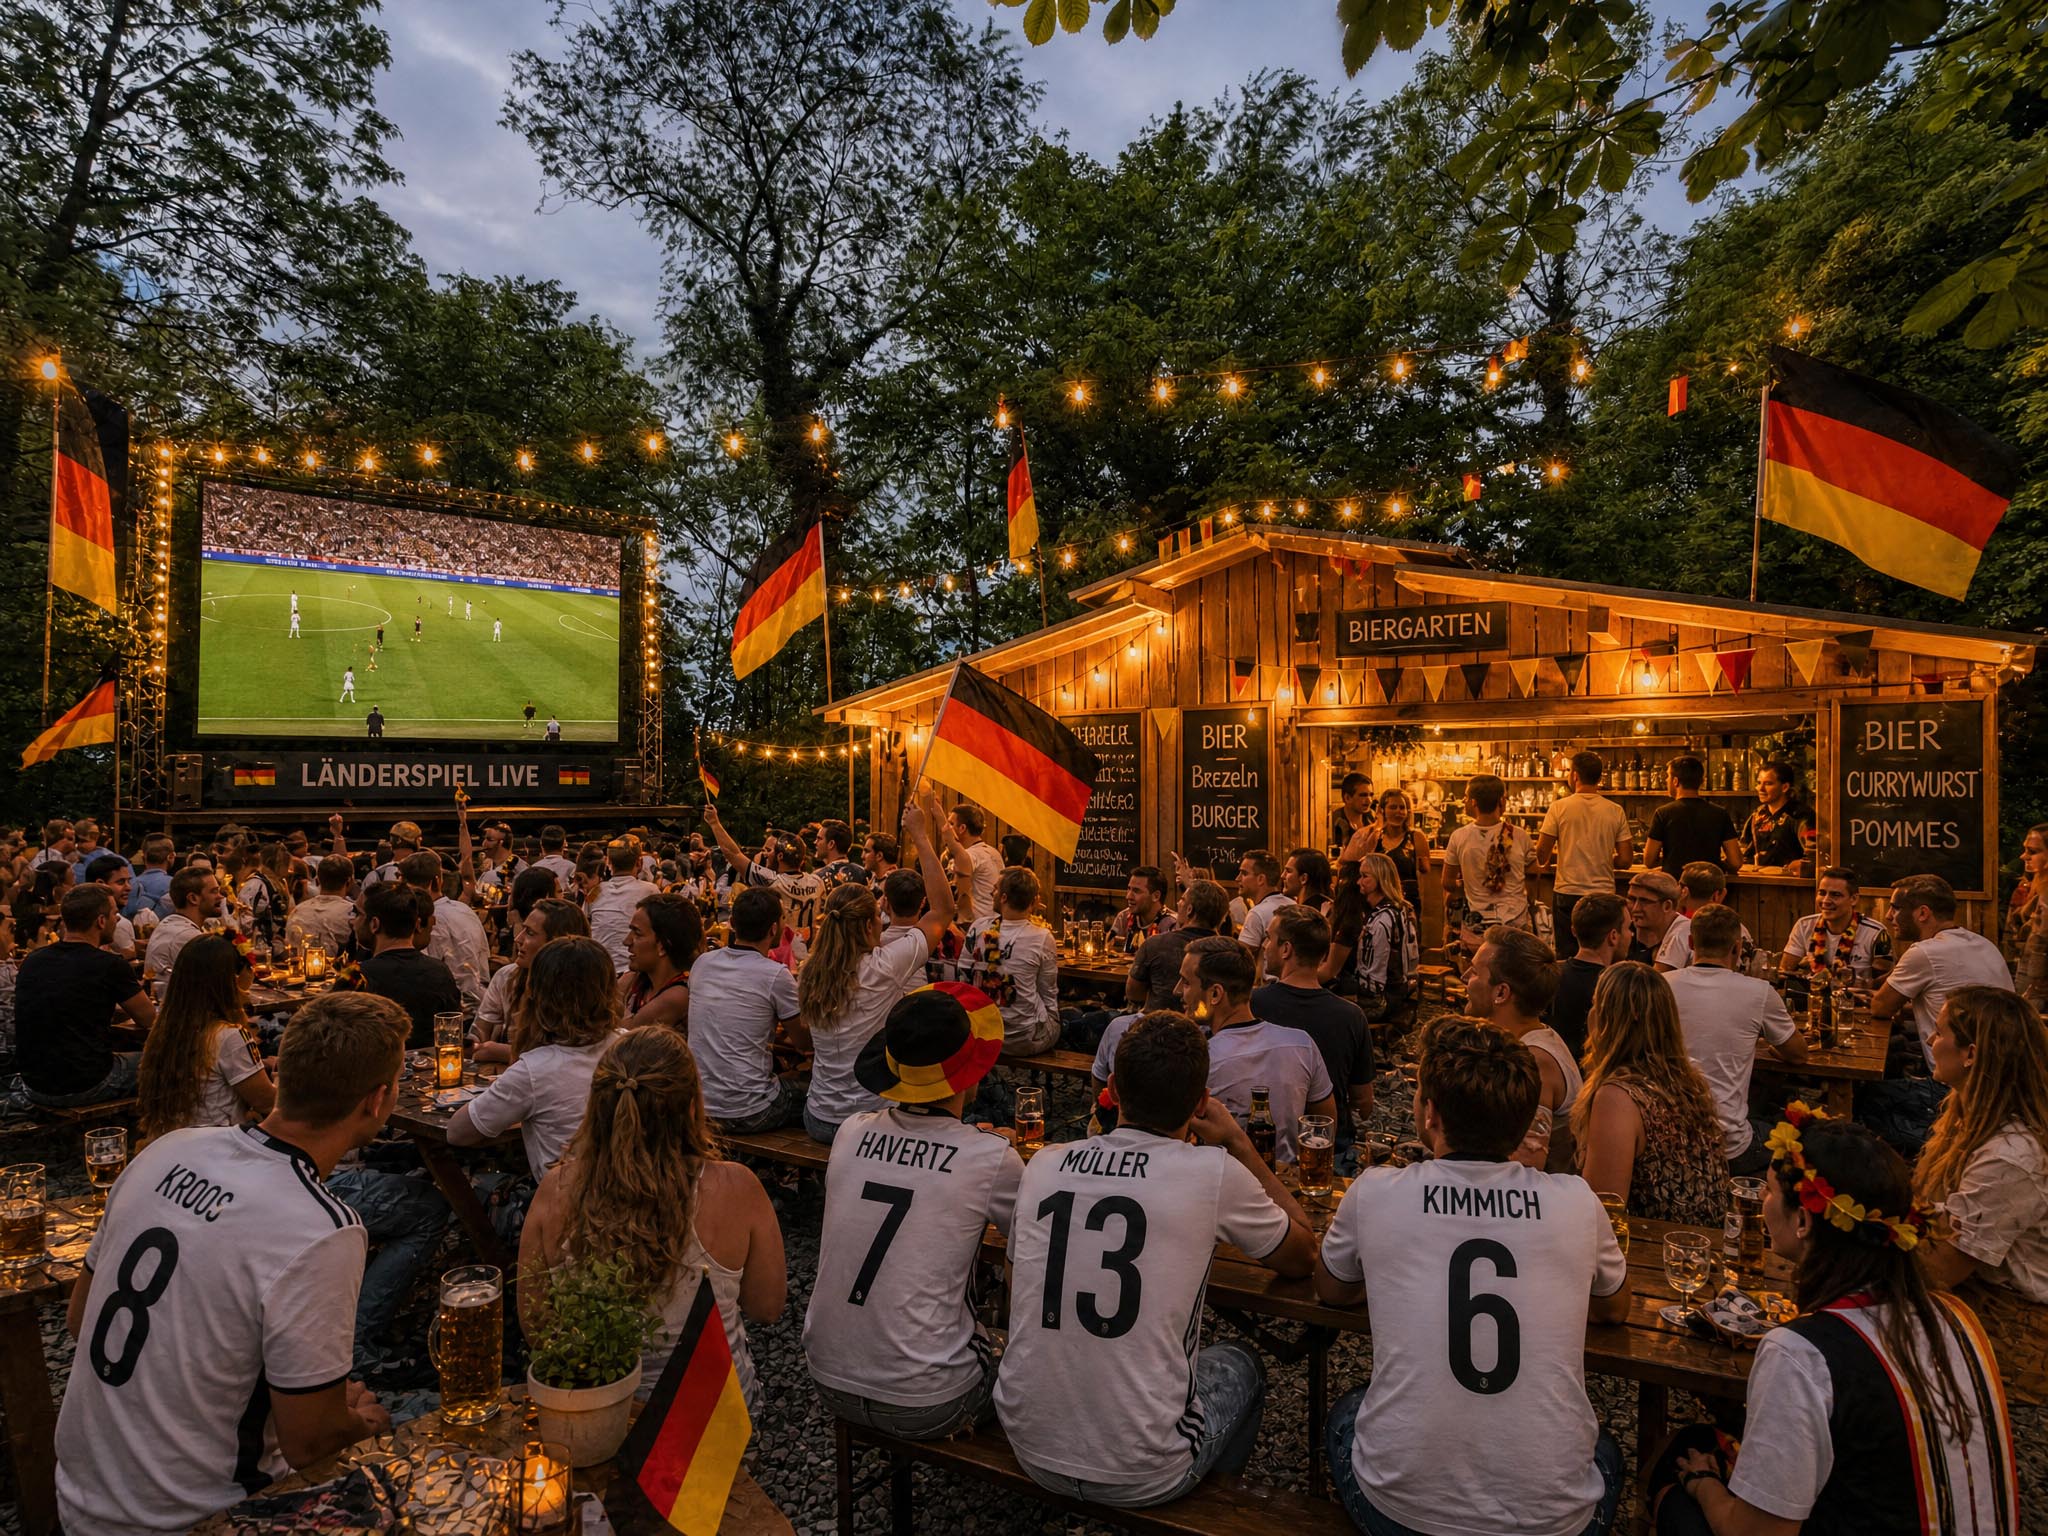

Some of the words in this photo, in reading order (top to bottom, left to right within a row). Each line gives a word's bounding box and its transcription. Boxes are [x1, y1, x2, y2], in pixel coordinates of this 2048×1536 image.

[1349, 611, 1491, 643] BIERGARTEN
[1202, 724, 1248, 749] BIER
[1865, 719, 1942, 750] BIER
[302, 757, 480, 787] LÄNDERSPIEL
[488, 764, 540, 787] LIVE
[1847, 771, 1979, 798] CURRYWURST
[1191, 804, 1260, 829] BURGER
[1850, 819, 1960, 849] POMMES
[855, 1131, 959, 1174] HAVERTZ
[1059, 1146, 1149, 1178] MÜLLER
[155, 1163, 234, 1223] KROOS
[1423, 1185, 1541, 1220] KIMMICH
[847, 1180, 915, 1306] 7
[1036, 1190, 1147, 1339] 13
[90, 1226, 179, 1387] 8
[1448, 1238, 1520, 1394] 6
